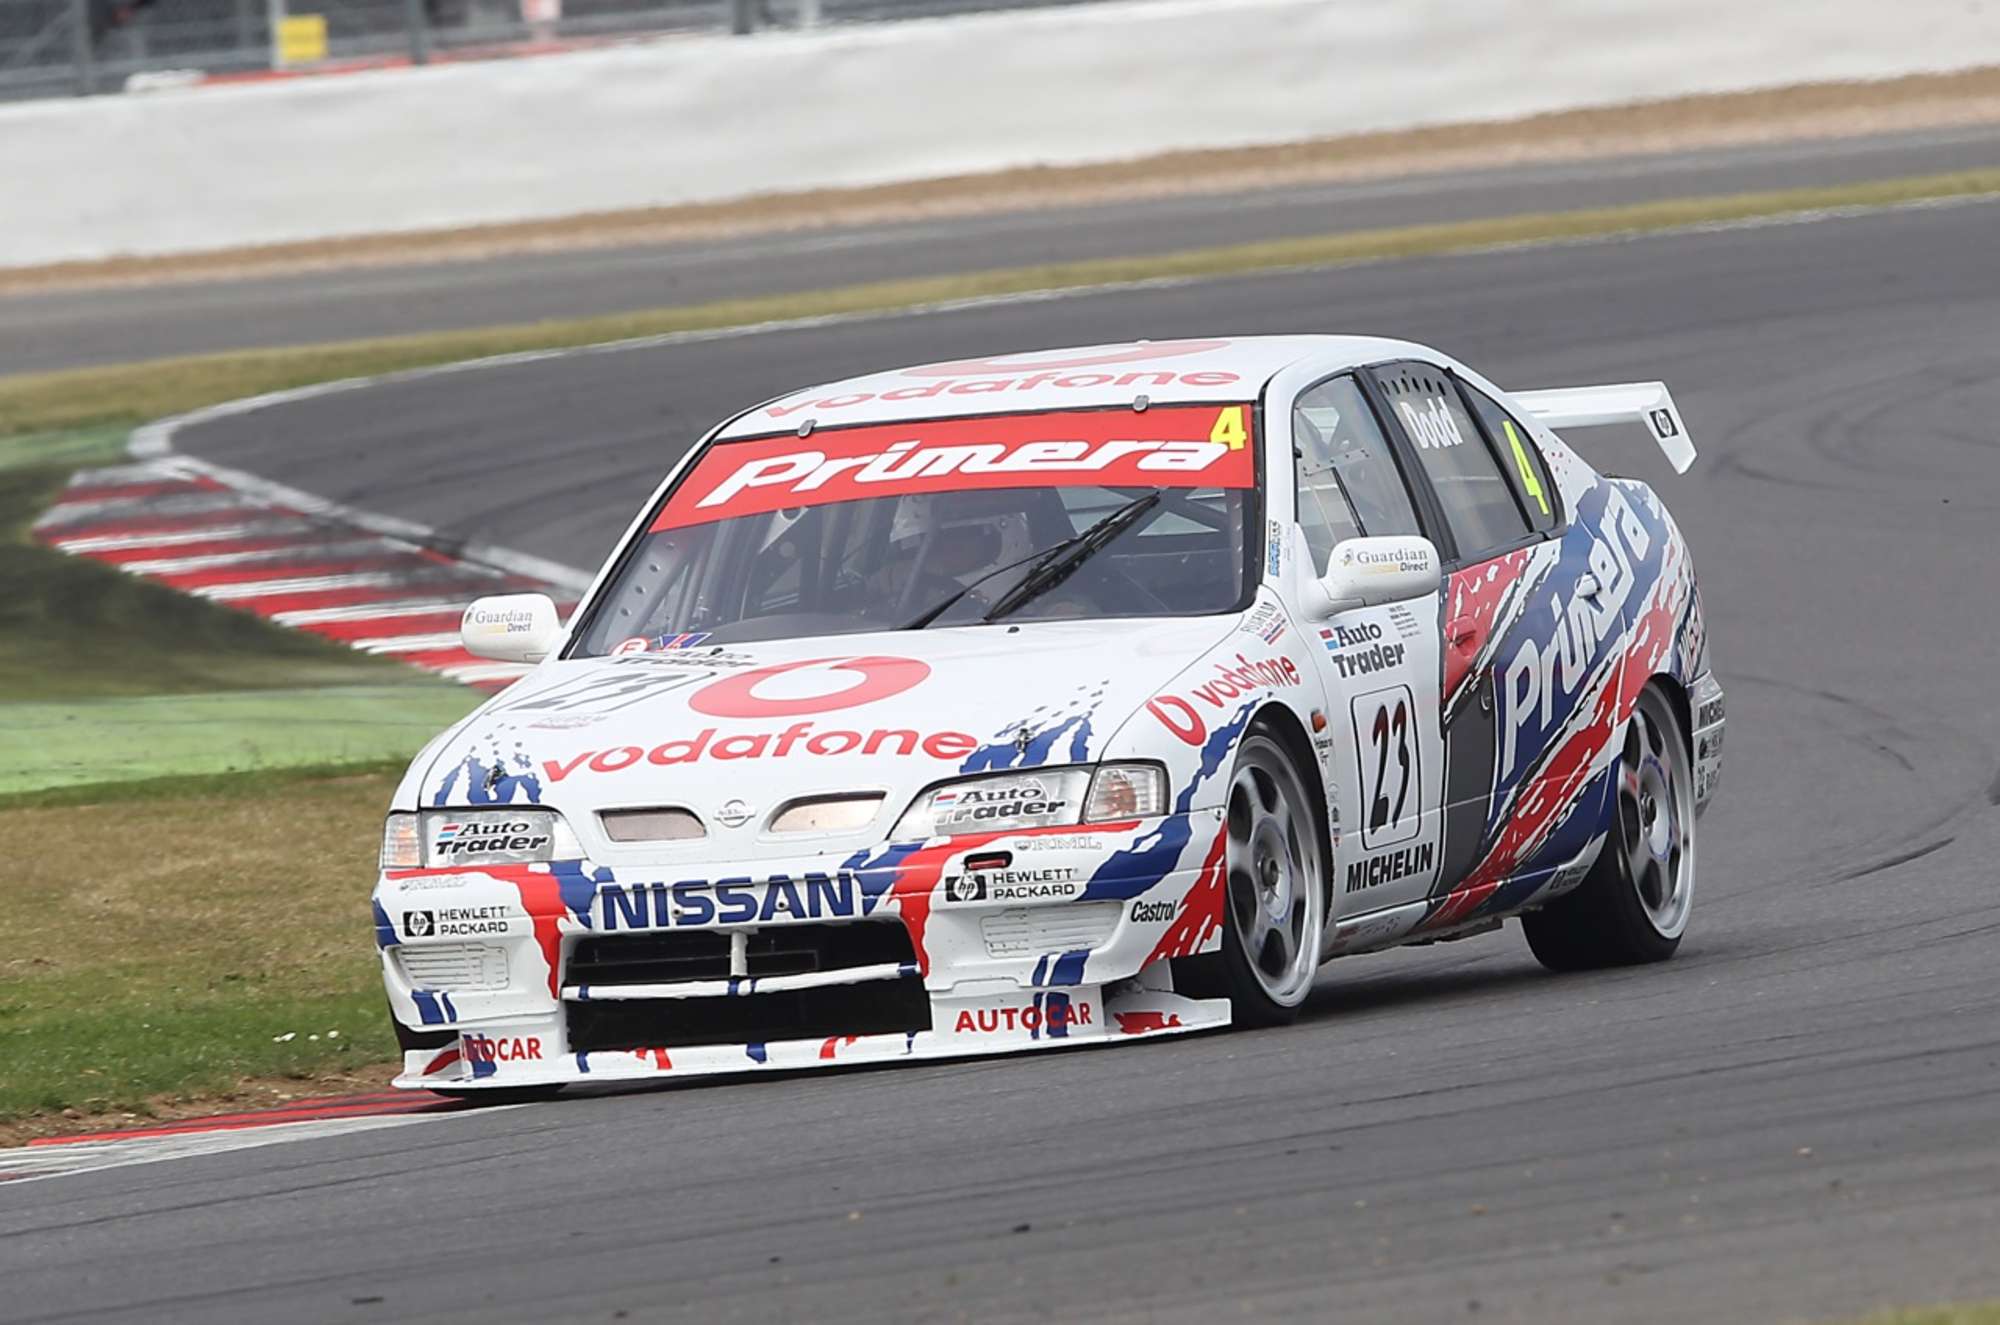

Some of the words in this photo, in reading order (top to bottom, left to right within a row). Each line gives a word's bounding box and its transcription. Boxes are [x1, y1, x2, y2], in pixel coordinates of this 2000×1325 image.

[765, 371, 1240, 418] vodafone
[1209, 405, 1246, 451] 4
[1400, 396, 1463, 449] Dodd
[696, 439, 1228, 509] Primera
[1503, 420, 1549, 514] 4
[1357, 548, 1428, 563] Guardian
[1400, 561, 1429, 572] Direct
[474, 607, 533, 625] Guardian
[507, 622, 532, 633] Direct
[1335, 621, 1382, 648] Auto
[1502, 484, 1649, 783] Primera
[1332, 643, 1406, 678] Trader
[1192, 653, 1302, 709] vodafone
[542, 722, 978, 782] vodafone
[1370, 700, 1410, 835] 23
[959, 788, 1041, 803] Auto
[454, 820, 530, 838] Auto
[435, 834, 549, 857] Trader
[993, 868, 1073, 884] HEWLETT
[1346, 842, 1433, 893] MICHELIN
[600, 872, 855, 931] NISSAN
[994, 884, 1075, 899] PACKARD
[439, 906, 506, 920] HEWLETT
[1131, 900, 1178, 923] Castrol
[441, 921, 509, 936] PACKARD
[955, 1002, 1092, 1033] AUTOCAR
